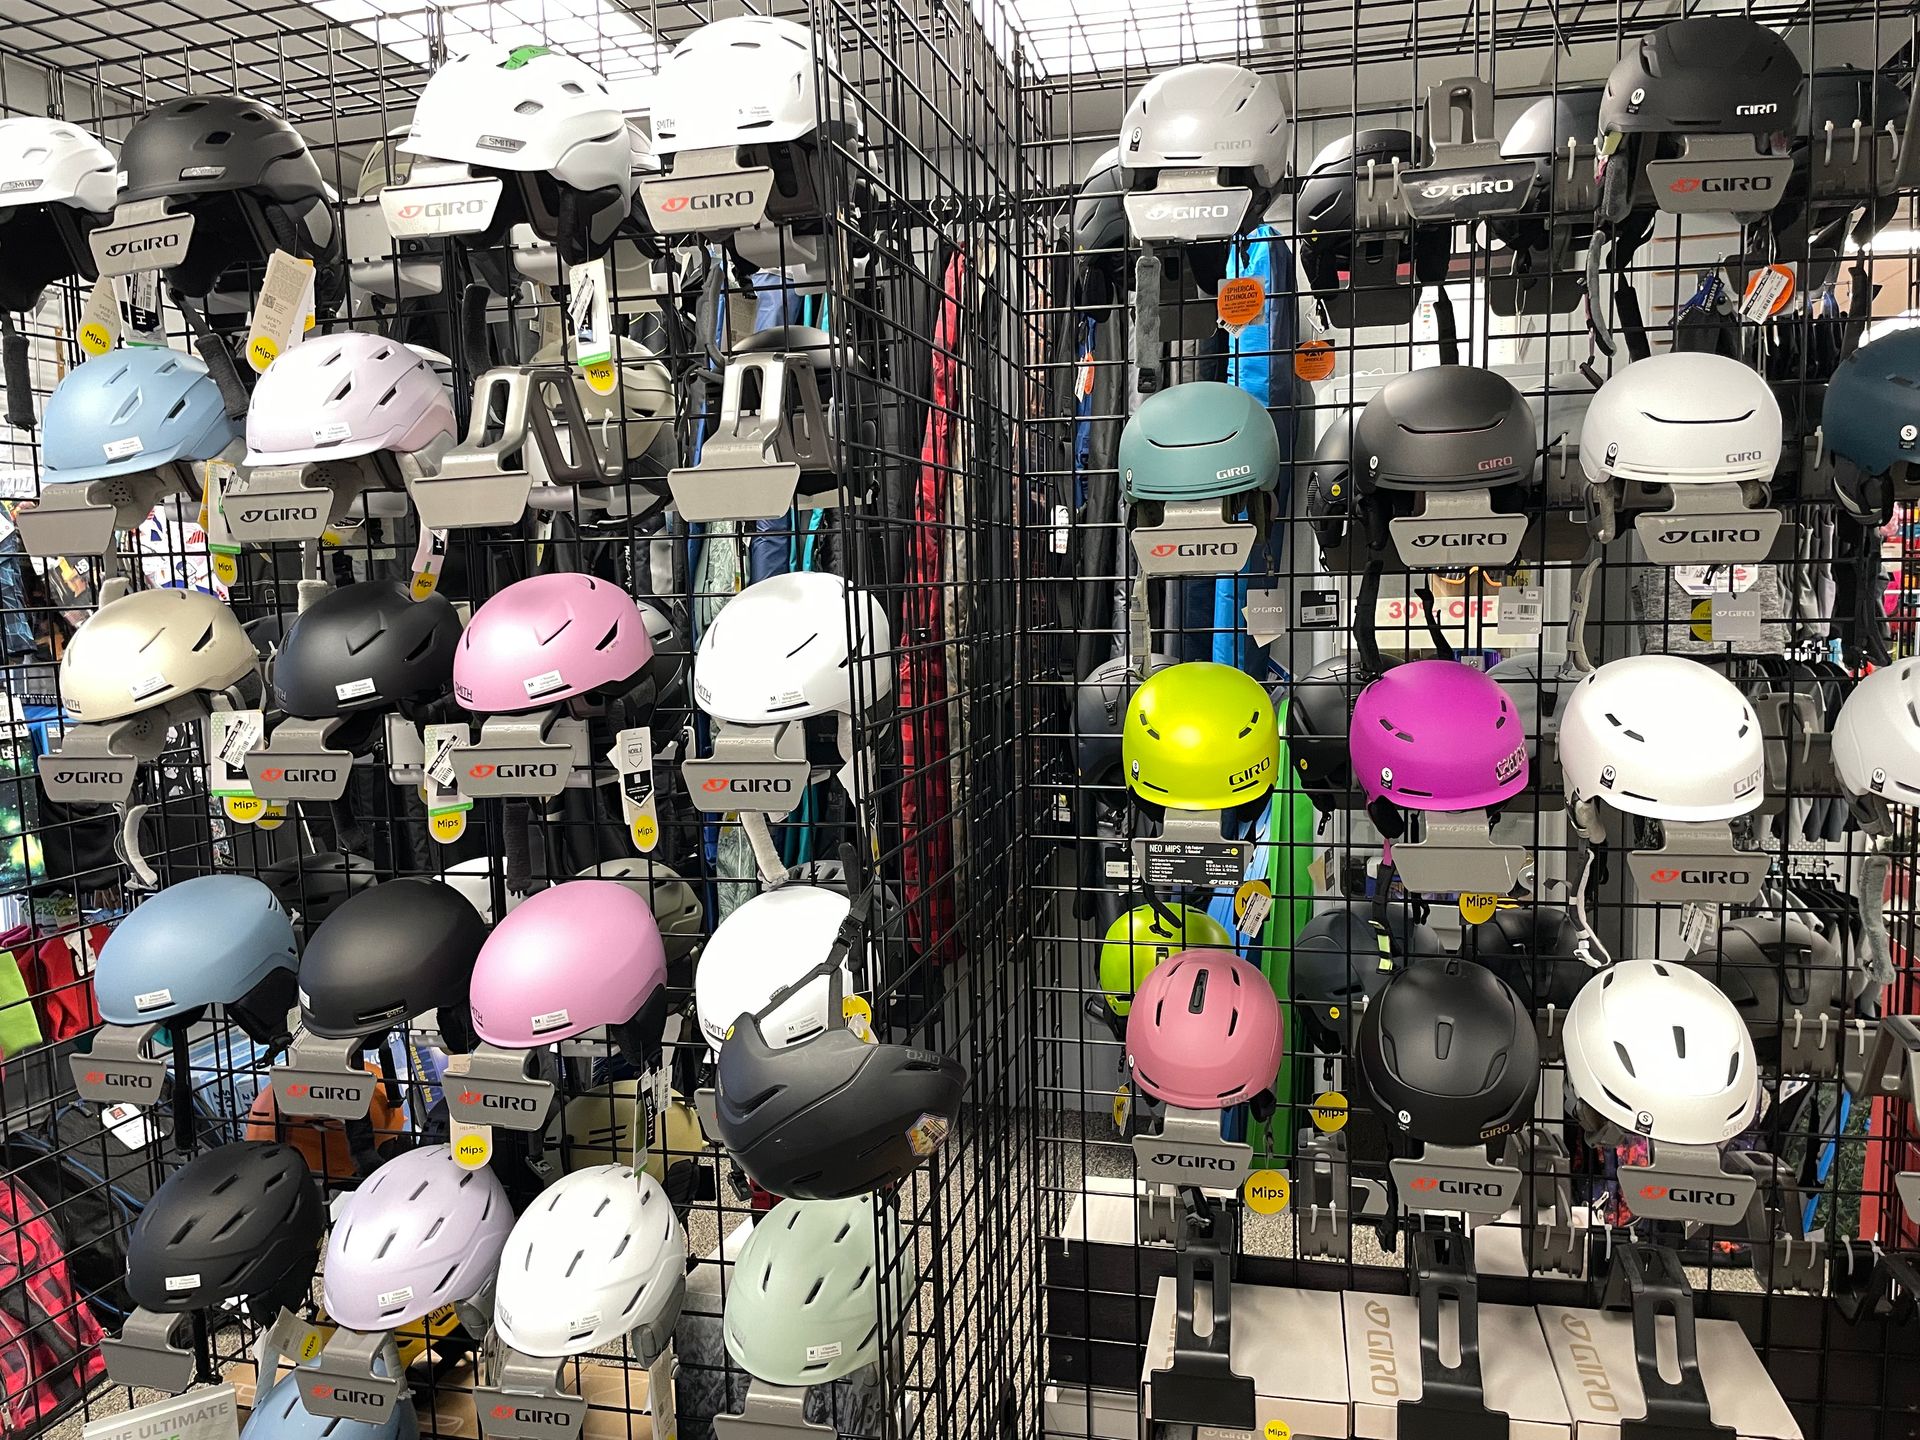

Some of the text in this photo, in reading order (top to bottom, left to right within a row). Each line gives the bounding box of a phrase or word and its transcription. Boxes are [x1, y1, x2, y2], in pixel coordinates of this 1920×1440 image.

[1633, 92, 1643, 101] M
[1736, 103, 1777, 115] GIRO
[657, 119, 675, 130] SMITH
[1134, 131, 1139, 139] S
[489, 138, 515, 148] SMITH
[1452, 180, 1514, 196] GIRO
[1702, 176, 1771, 192] GIRO
[691, 191, 753, 210] GIRO
[425, 200, 483, 217] GIRO
[1173, 205, 1228, 219] GIRO
[129, 234, 178, 253] GIRO
[1227, 285, 1255, 294] SPHERICAL
[1225, 292, 1258, 303] TECHNOLOGY
[85, 330, 106, 348] Mips
[255, 345, 275, 361] Mips
[591, 368, 610, 379] Mips
[1905, 429, 1912, 437] S
[1477, 456, 1512, 471] GIRO
[1725, 451, 1761, 463] GIRO
[1216, 465, 1250, 480] GIRO
[265, 507, 317, 521] GIRO
[1441, 533, 1507, 546] GIRO
[1691, 529, 1760, 543] GIRO
[1178, 543, 1237, 556] GIRO
[218, 563, 232, 572] Mips
[417, 579, 432, 588] Mips
[76, 772, 122, 783] GIRO
[284, 769, 336, 782] GIRO
[497, 764, 556, 778] GIRO
[1229, 757, 1270, 785] GIRO
[1604, 768, 1613, 777] M
[730, 779, 791, 792] GIRO
[234, 801, 258, 810] Mips
[438, 818, 459, 828] Mips
[638, 827, 653, 837] Mips
[1150, 844, 1162, 852] NEO
[1165, 845, 1181, 853] MIPS
[1681, 871, 1749, 884] GIRO
[1466, 895, 1493, 908] Mips
[105, 1073, 152, 1088] GIRO
[309, 1086, 360, 1101] GIRO
[483, 1095, 536, 1111] GIRO
[645, 1096, 656, 1140] SMITH
[1401, 1112, 1409, 1121] M
[1480, 1123, 1510, 1139] GIRO
[1722, 1122, 1743, 1138] GIRO
[460, 1146, 483, 1155] Mips
[1178, 1155, 1235, 1171] GIRO
[1252, 1186, 1284, 1200] Mips
[1439, 1180, 1502, 1196] GIRO
[1669, 1188, 1735, 1206] GIRO
[304, 1334, 317, 1358] Mips
[1367, 1330, 1399, 1397] GIRO
[1570, 1344, 1619, 1412] GIRO
[334, 1388, 384, 1407] GIRO
[139, 1402, 229, 1439] ULTIMATE
[515, 1408, 570, 1426] GIRO
[1268, 1428, 1287, 1438] Mips
